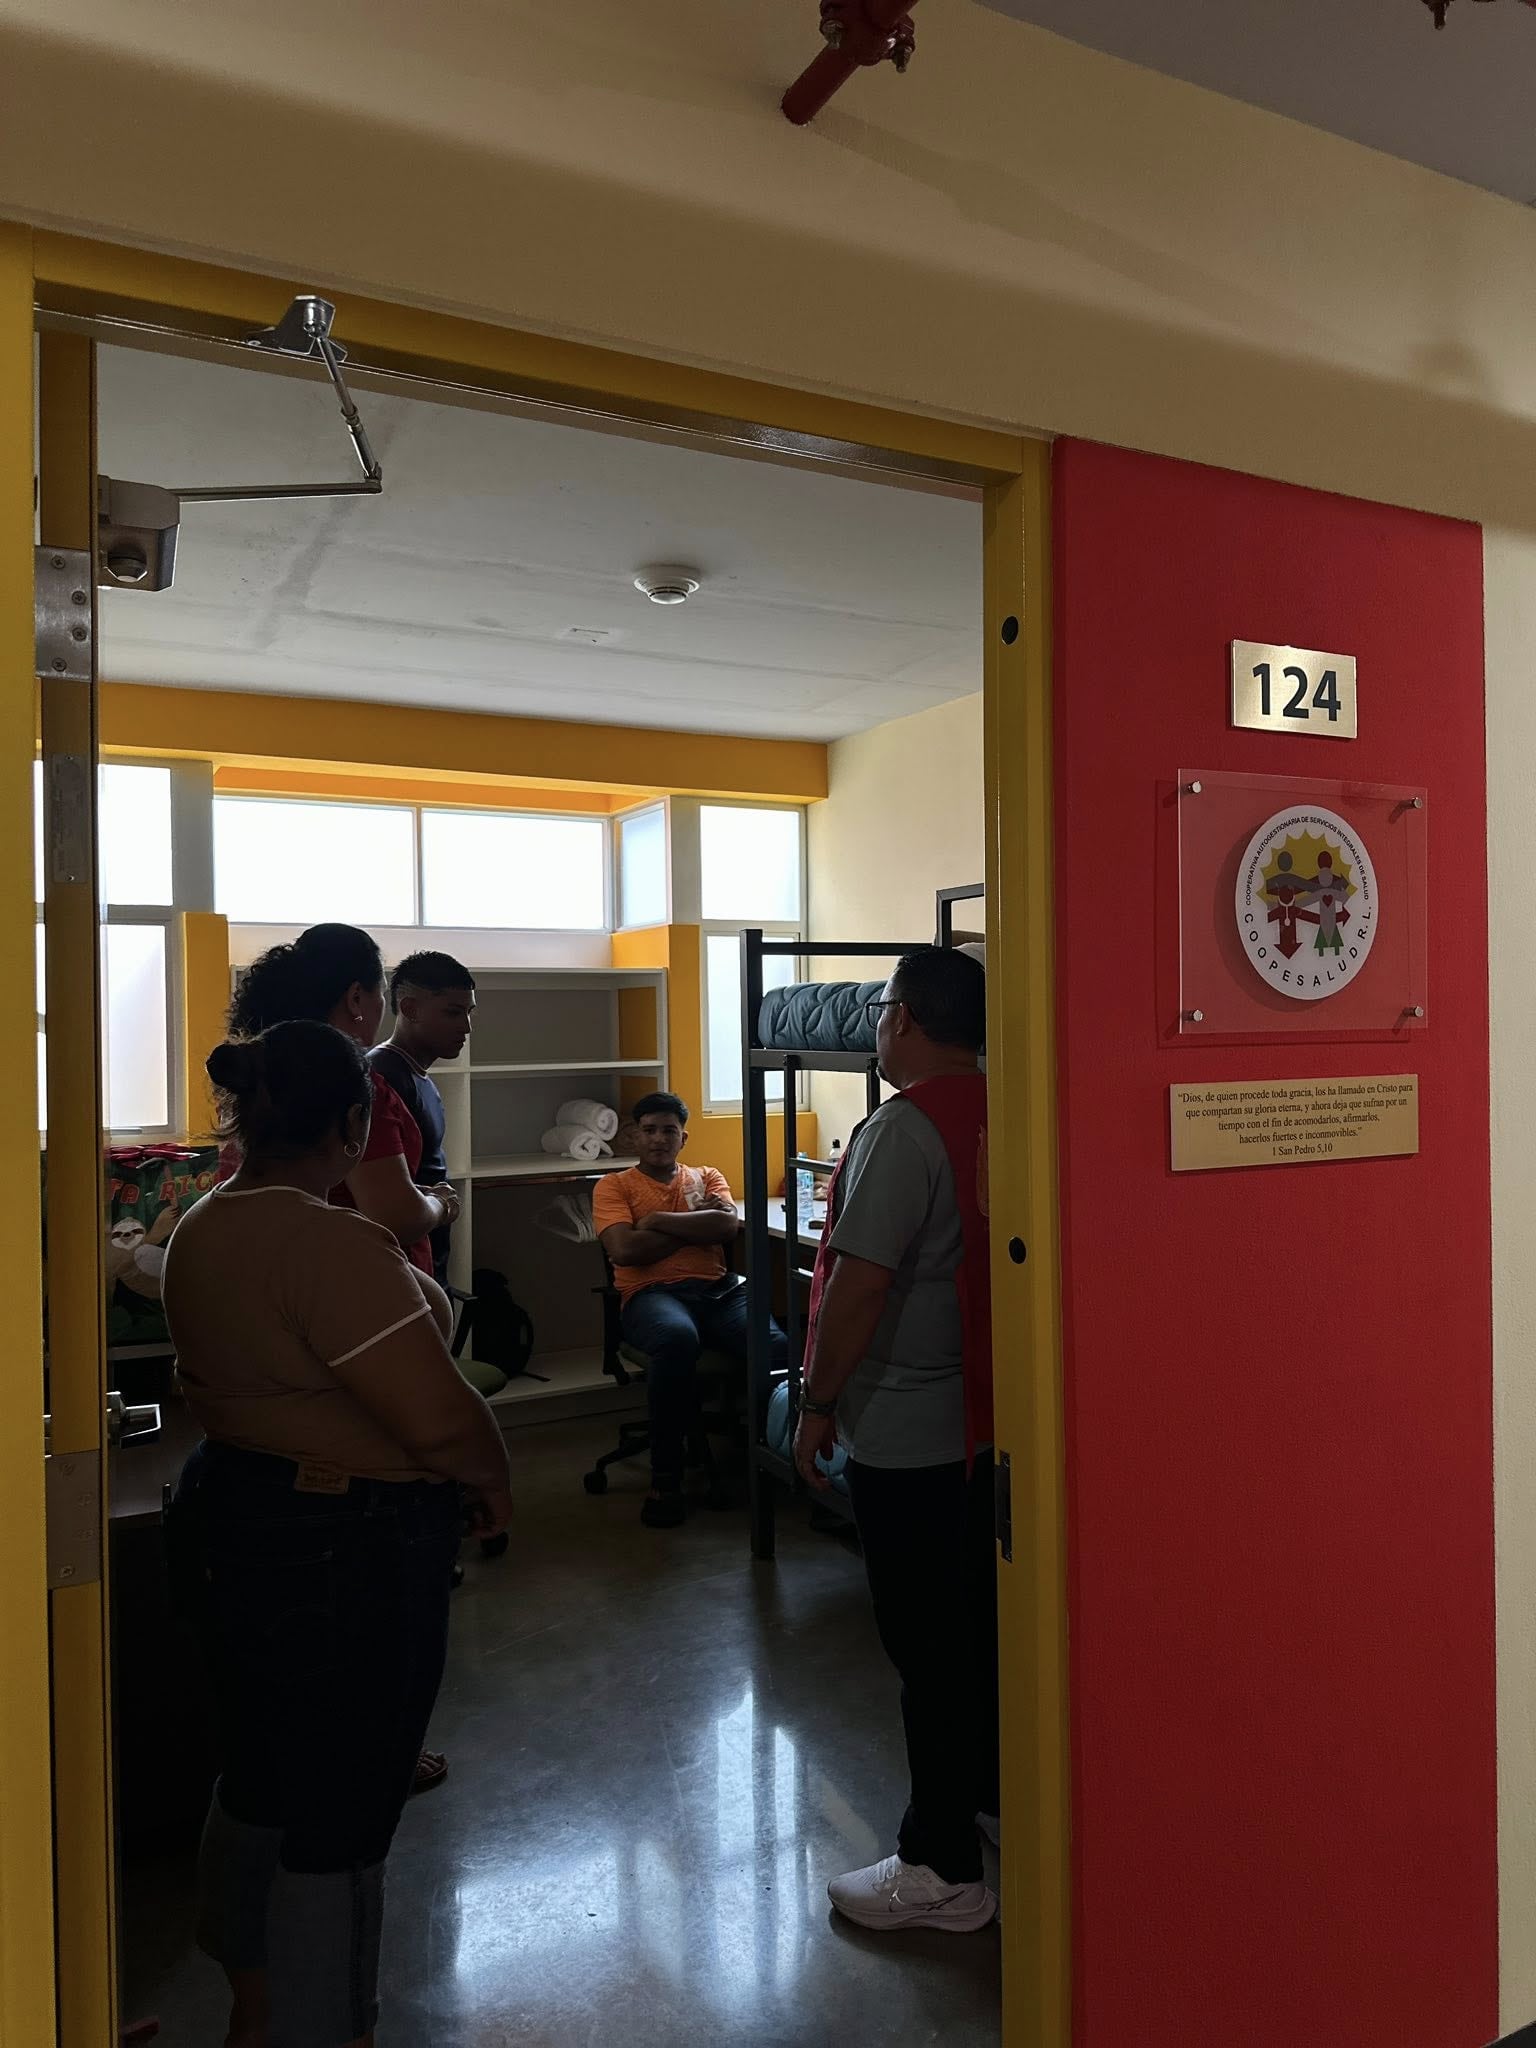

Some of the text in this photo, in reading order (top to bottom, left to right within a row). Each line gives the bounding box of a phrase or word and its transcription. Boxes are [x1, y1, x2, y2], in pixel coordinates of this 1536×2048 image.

[1252, 663, 1341, 721] 124
[1310, 817, 1338, 833] SERVICIOS
[1257, 816, 1301, 857] AUTOGESTIONARIA
[1337, 829, 1362, 865] INTEGRALES
[1246, 855, 1259, 905] COOPERATIVA
[1358, 864, 1366, 875] DE
[1361, 876, 1369, 900] SALUD
[1244, 906, 1372, 987] COOPESALUD R.L.
[1205, 1092, 1215, 1101] de
[1216, 1092, 1238, 1103] quien
[1240, 1089, 1270, 1103] procede
[1271, 1088, 1288, 1099] toda
[1289, 1087, 1314, 1100] gracia,
[1315, 1086, 1326, 1096] los
[1327, 1086, 1336, 1095] ha
[1338, 1085, 1366, 1095] llamado
[1366, 1086, 1376, 1094] en
[1376, 1083, 1398, 1093] Cristo
[1398, 1084, 1413, 1094] para
[1185, 1098, 1407, 1120] que compartan su gloria eterna, y ahora deja que sufran por un
[1218, 1112, 1380, 1132] tiempo con el fin de acomodarlos, afirmarlos,
[1239, 1132, 1271, 1144] hacerlos
[1272, 1131, 1297, 1142] fuertes
[1272, 1142, 1333, 1156] 1 San Pedro 5,10
